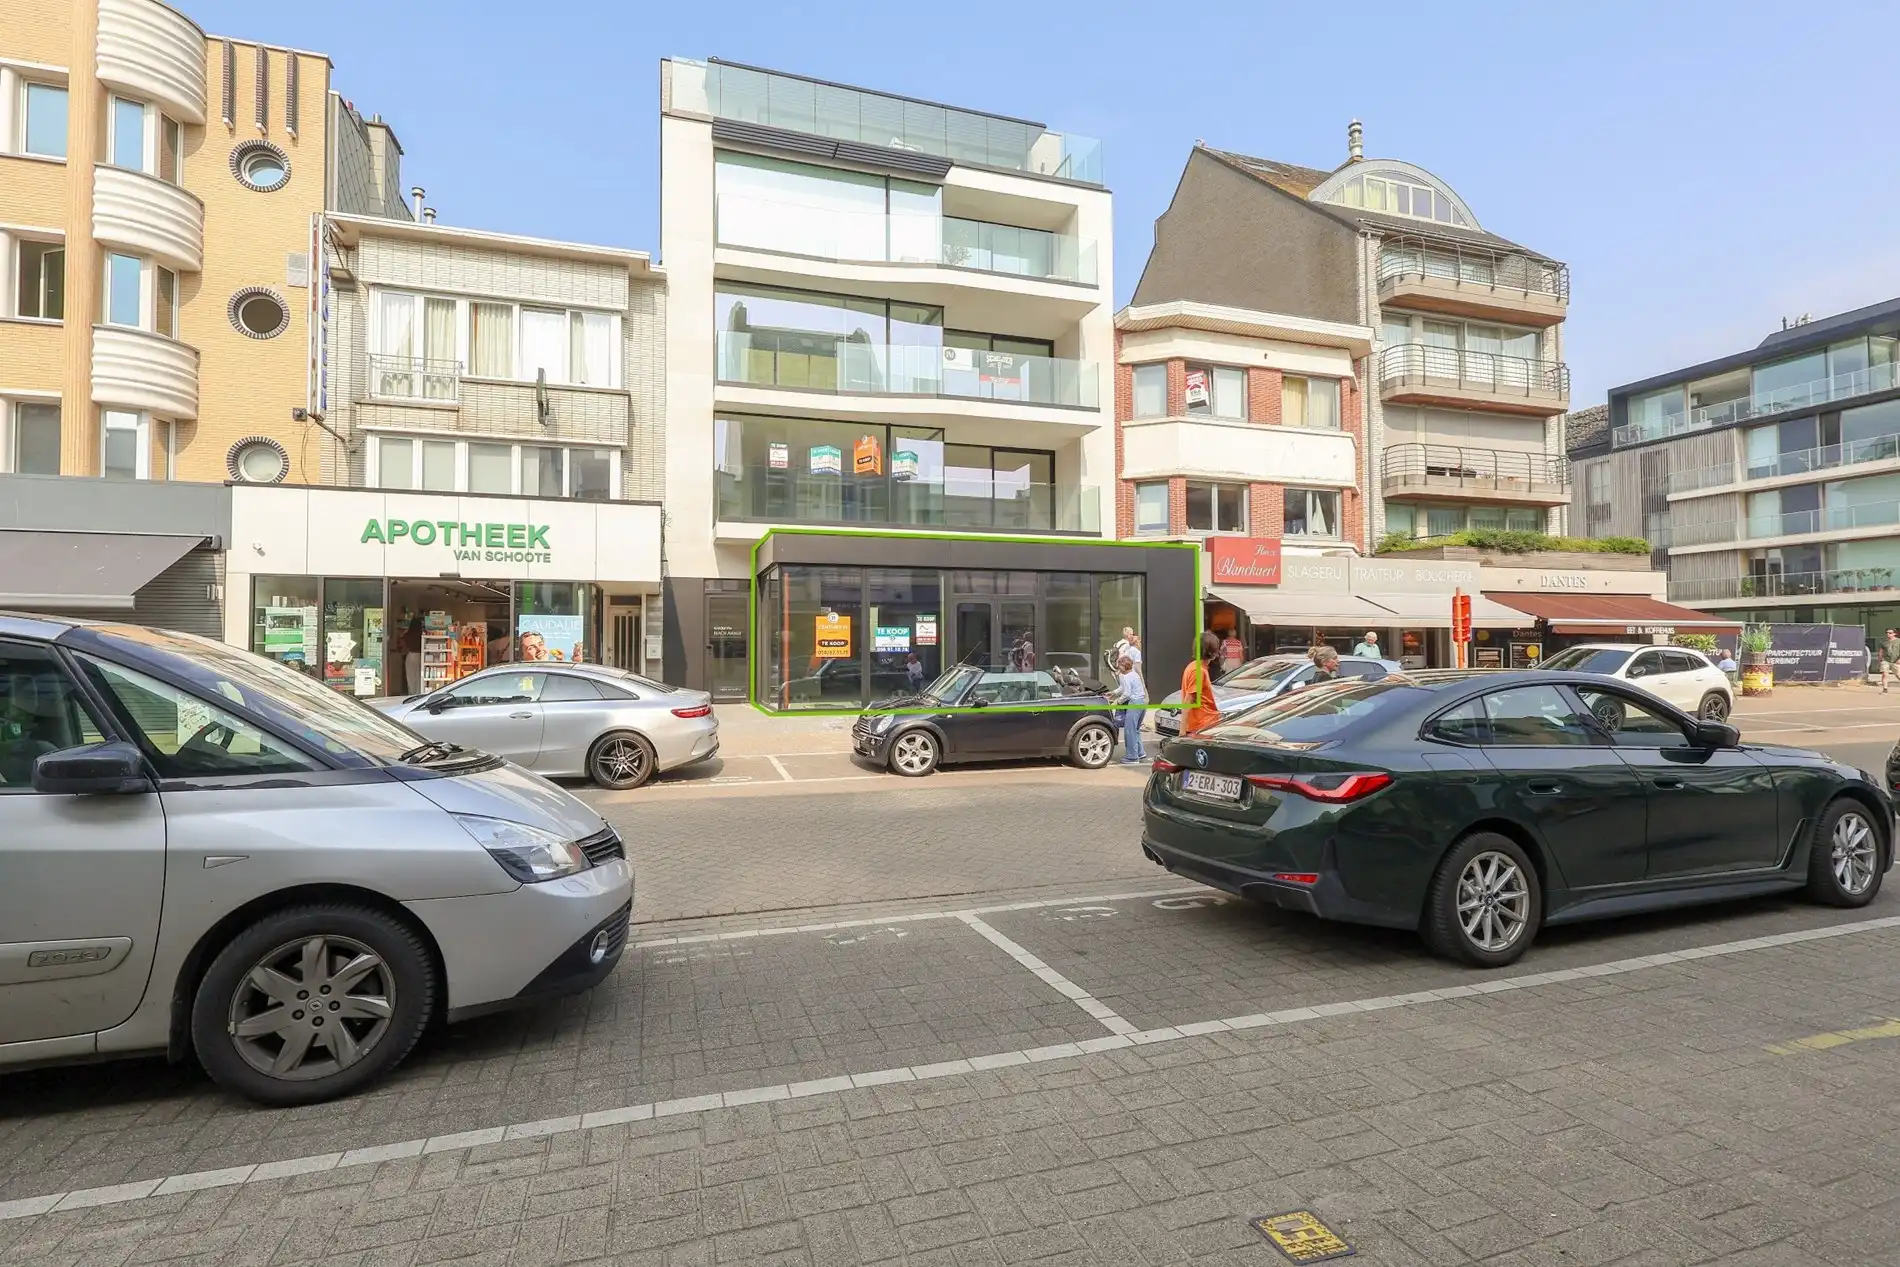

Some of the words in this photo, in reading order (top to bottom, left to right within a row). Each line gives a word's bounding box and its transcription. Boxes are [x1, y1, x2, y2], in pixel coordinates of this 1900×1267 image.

[360, 518, 551, 549] APOTHEEK
[453, 550, 481, 561] VAN
[485, 550, 551, 563] SCHOOTE
[1287, 565, 1342, 580] SLAGERIJ
[1354, 567, 1404, 581] TRAITEUR
[1540, 575, 1587, 588] DANTES
[521, 619, 581, 631] CAUDALIE
[887, 627, 909, 635] KOOP
[1637, 626, 1643, 635] &
[1512, 630, 1542, 638] Dantes
[1766, 649, 1823, 657] PARCHITECTUUR
